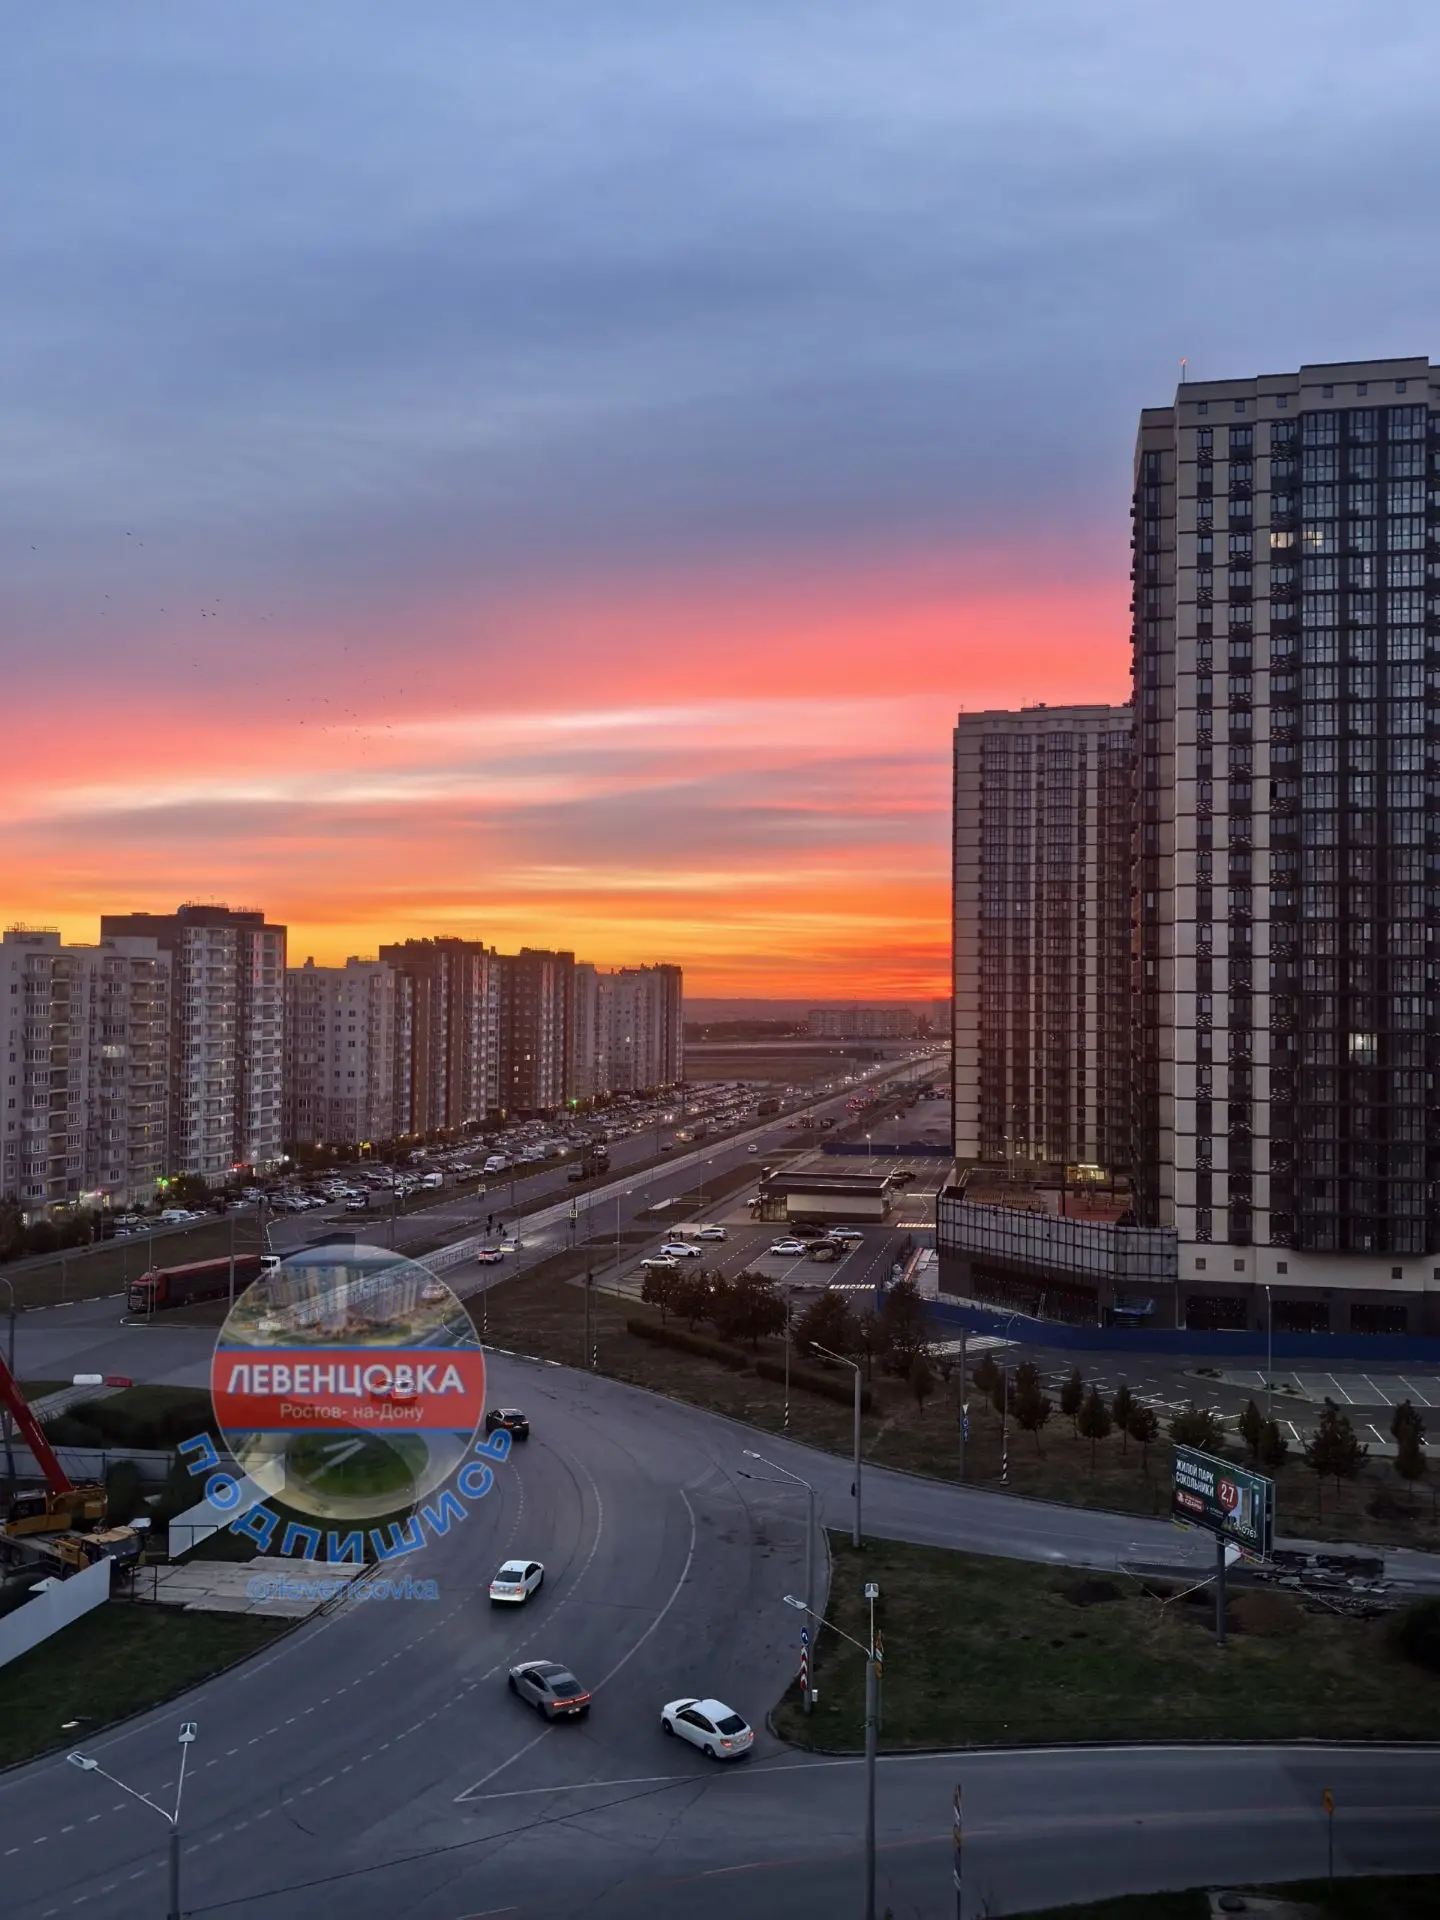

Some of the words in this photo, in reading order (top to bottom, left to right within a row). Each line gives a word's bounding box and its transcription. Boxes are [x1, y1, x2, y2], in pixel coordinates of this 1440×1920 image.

[1176, 1459, 1198, 1477] ЖИЛОЙ
[1198, 1467, 1214, 1484] ПАРК
[1176, 1471, 1214, 1497] СОКОЛЬНИКИ
